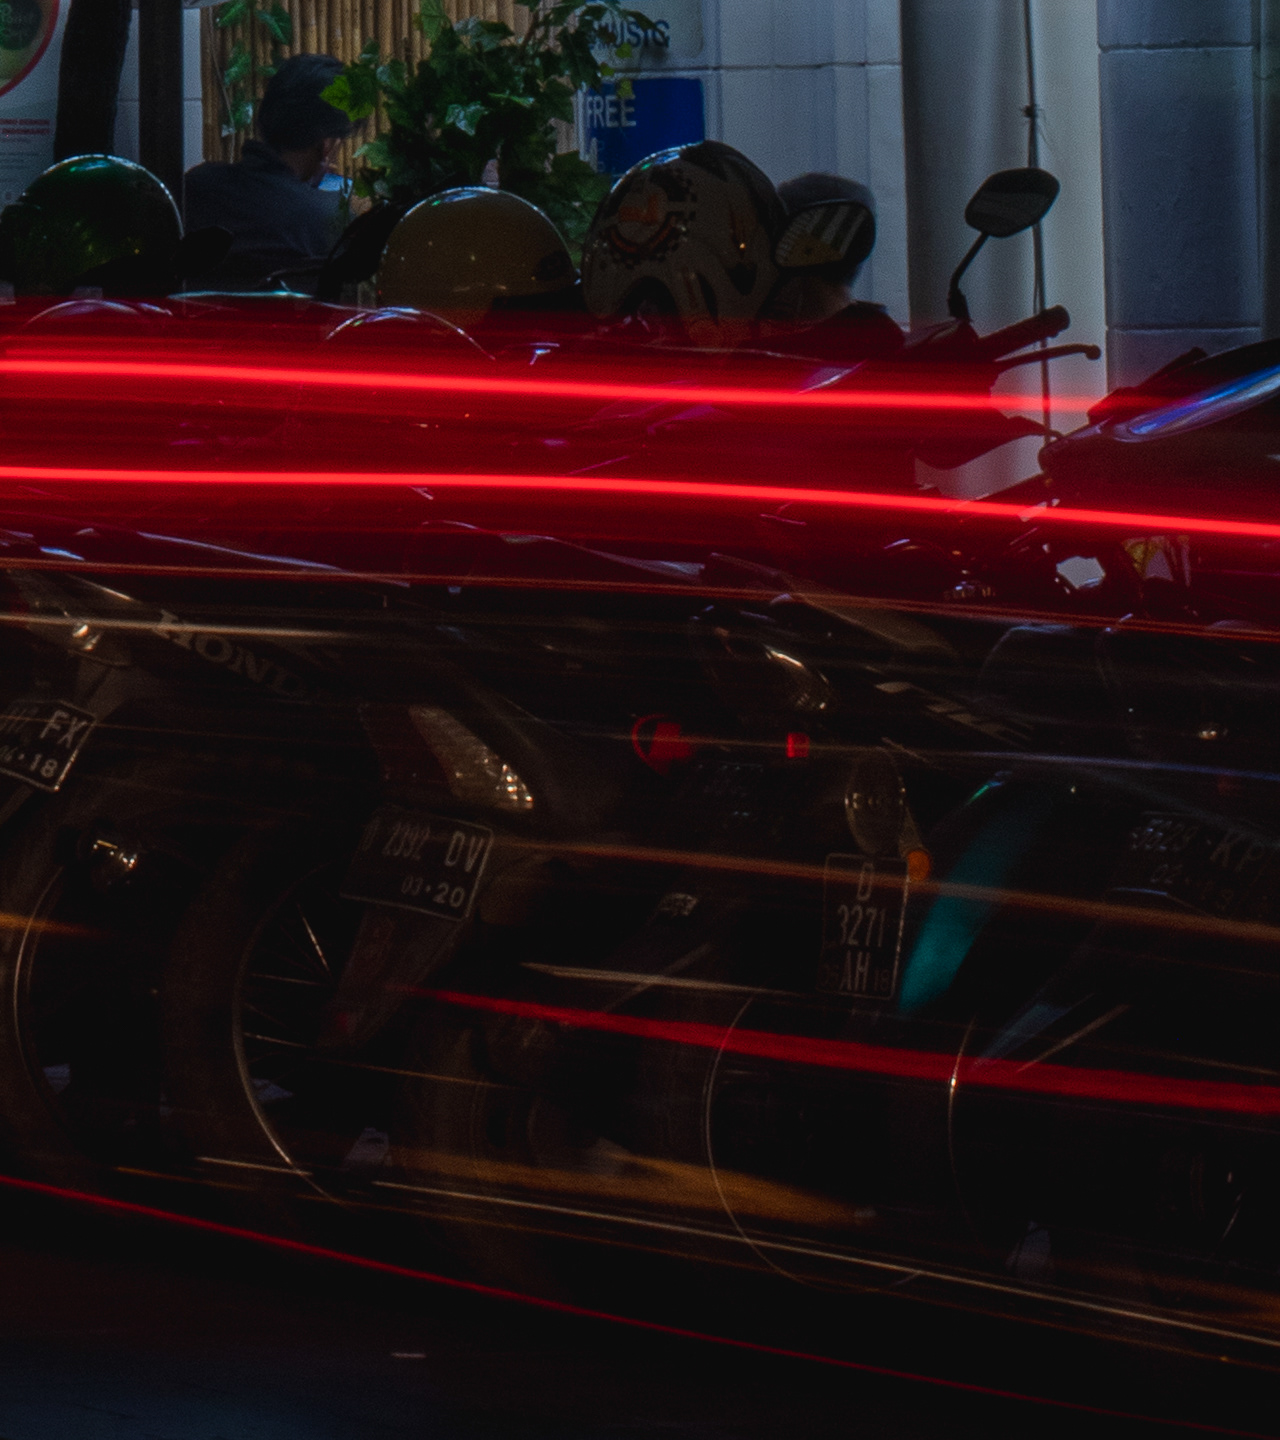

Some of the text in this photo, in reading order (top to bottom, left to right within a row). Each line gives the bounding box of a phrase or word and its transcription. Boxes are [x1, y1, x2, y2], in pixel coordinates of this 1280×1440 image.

[585, 94, 637, 128] FREE
[152, 608, 320, 701] HOND
[39, 709, 89, 750] FX
